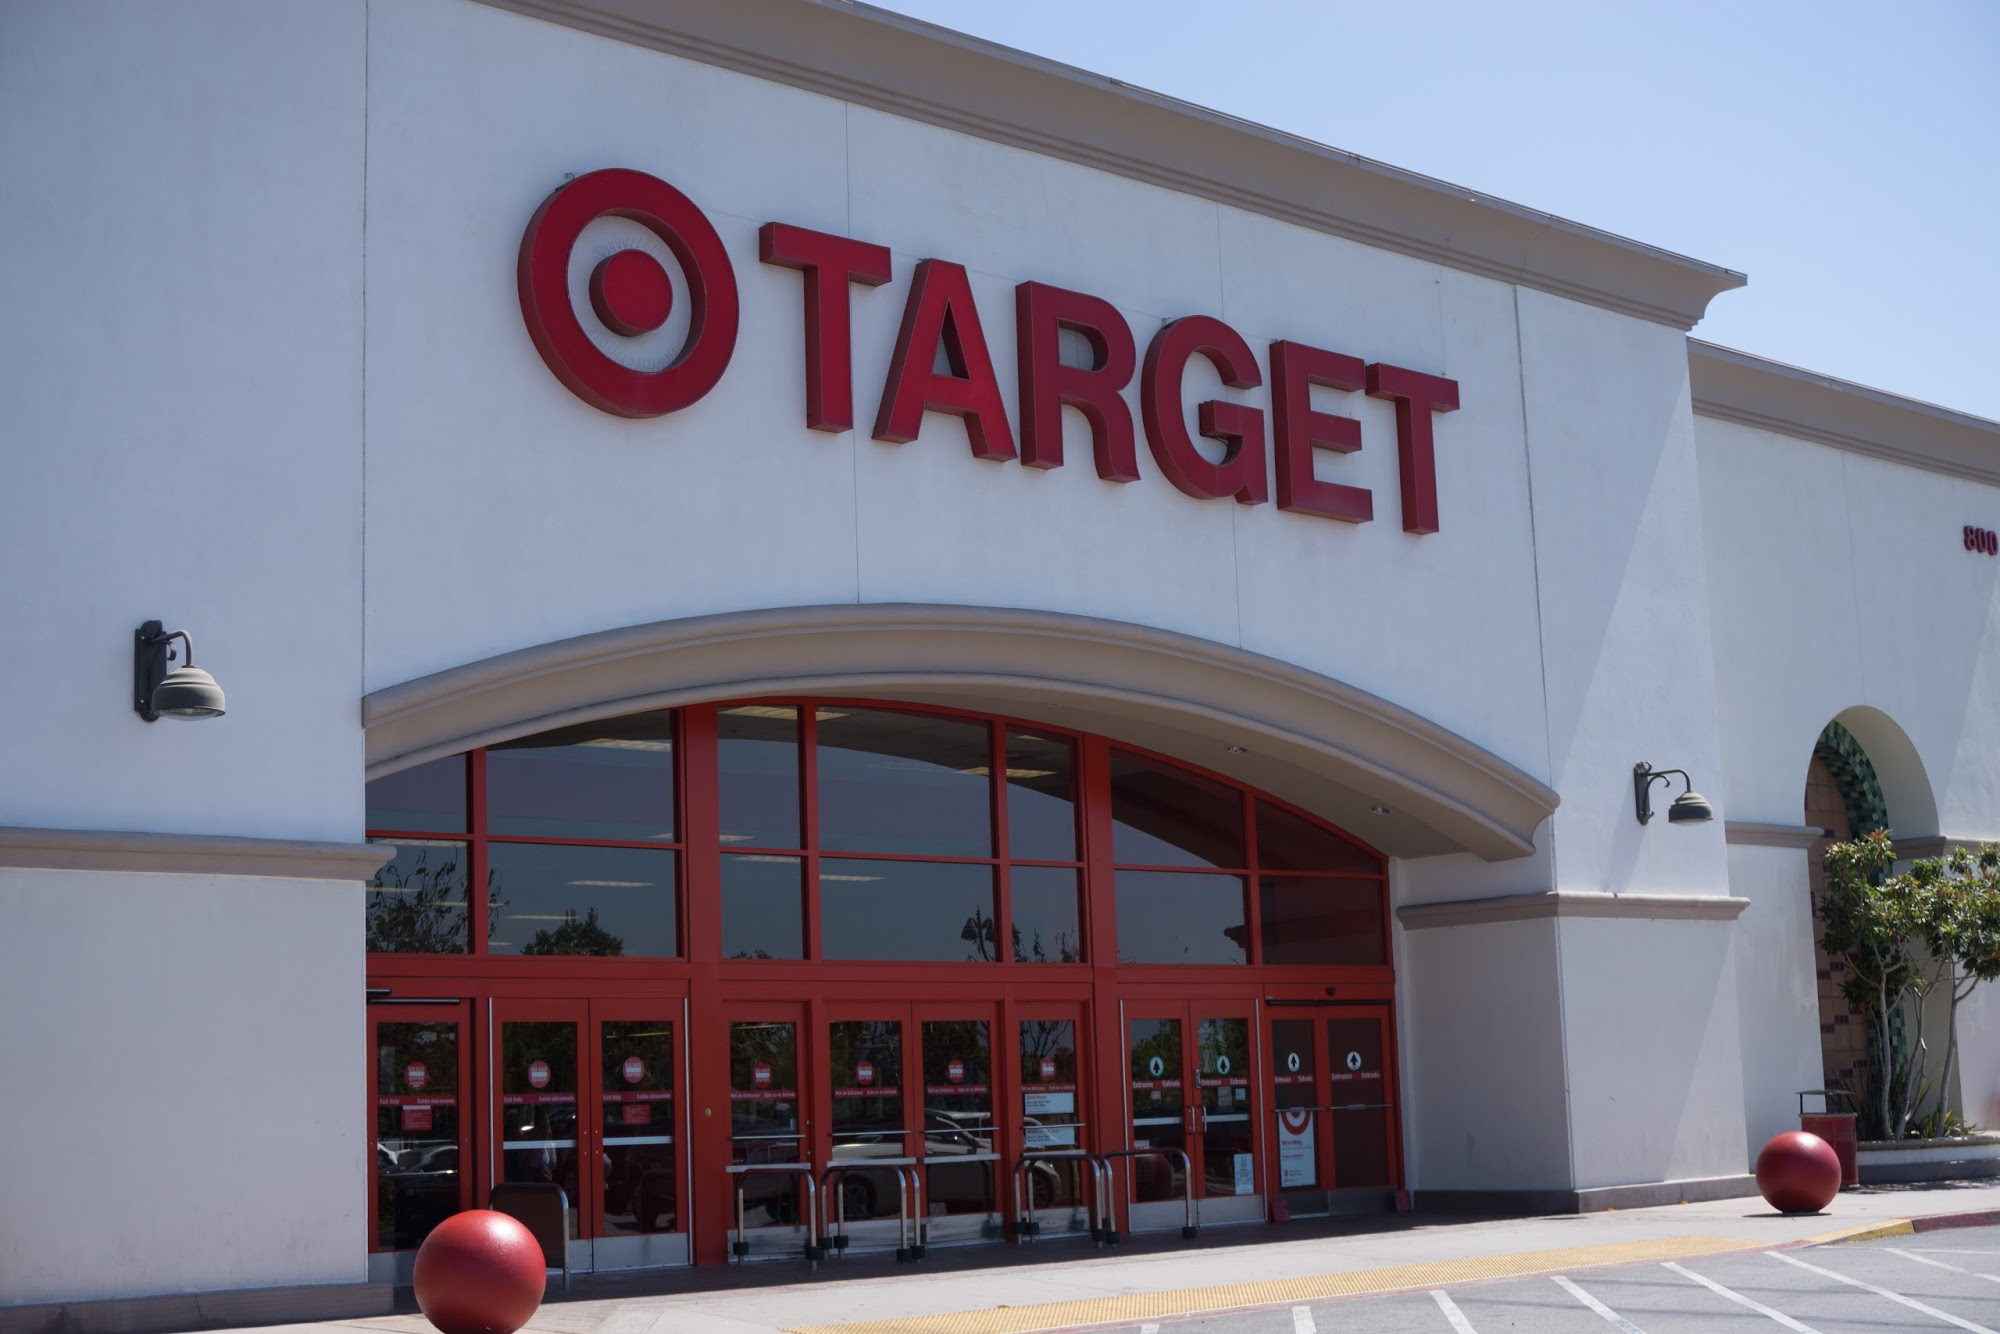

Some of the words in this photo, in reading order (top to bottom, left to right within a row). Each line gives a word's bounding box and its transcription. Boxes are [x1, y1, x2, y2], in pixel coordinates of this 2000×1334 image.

[759, 221, 1460, 535] TARGET
[1963, 525, 1998, 556] 800
[612, 1094, 621, 1102] Only
